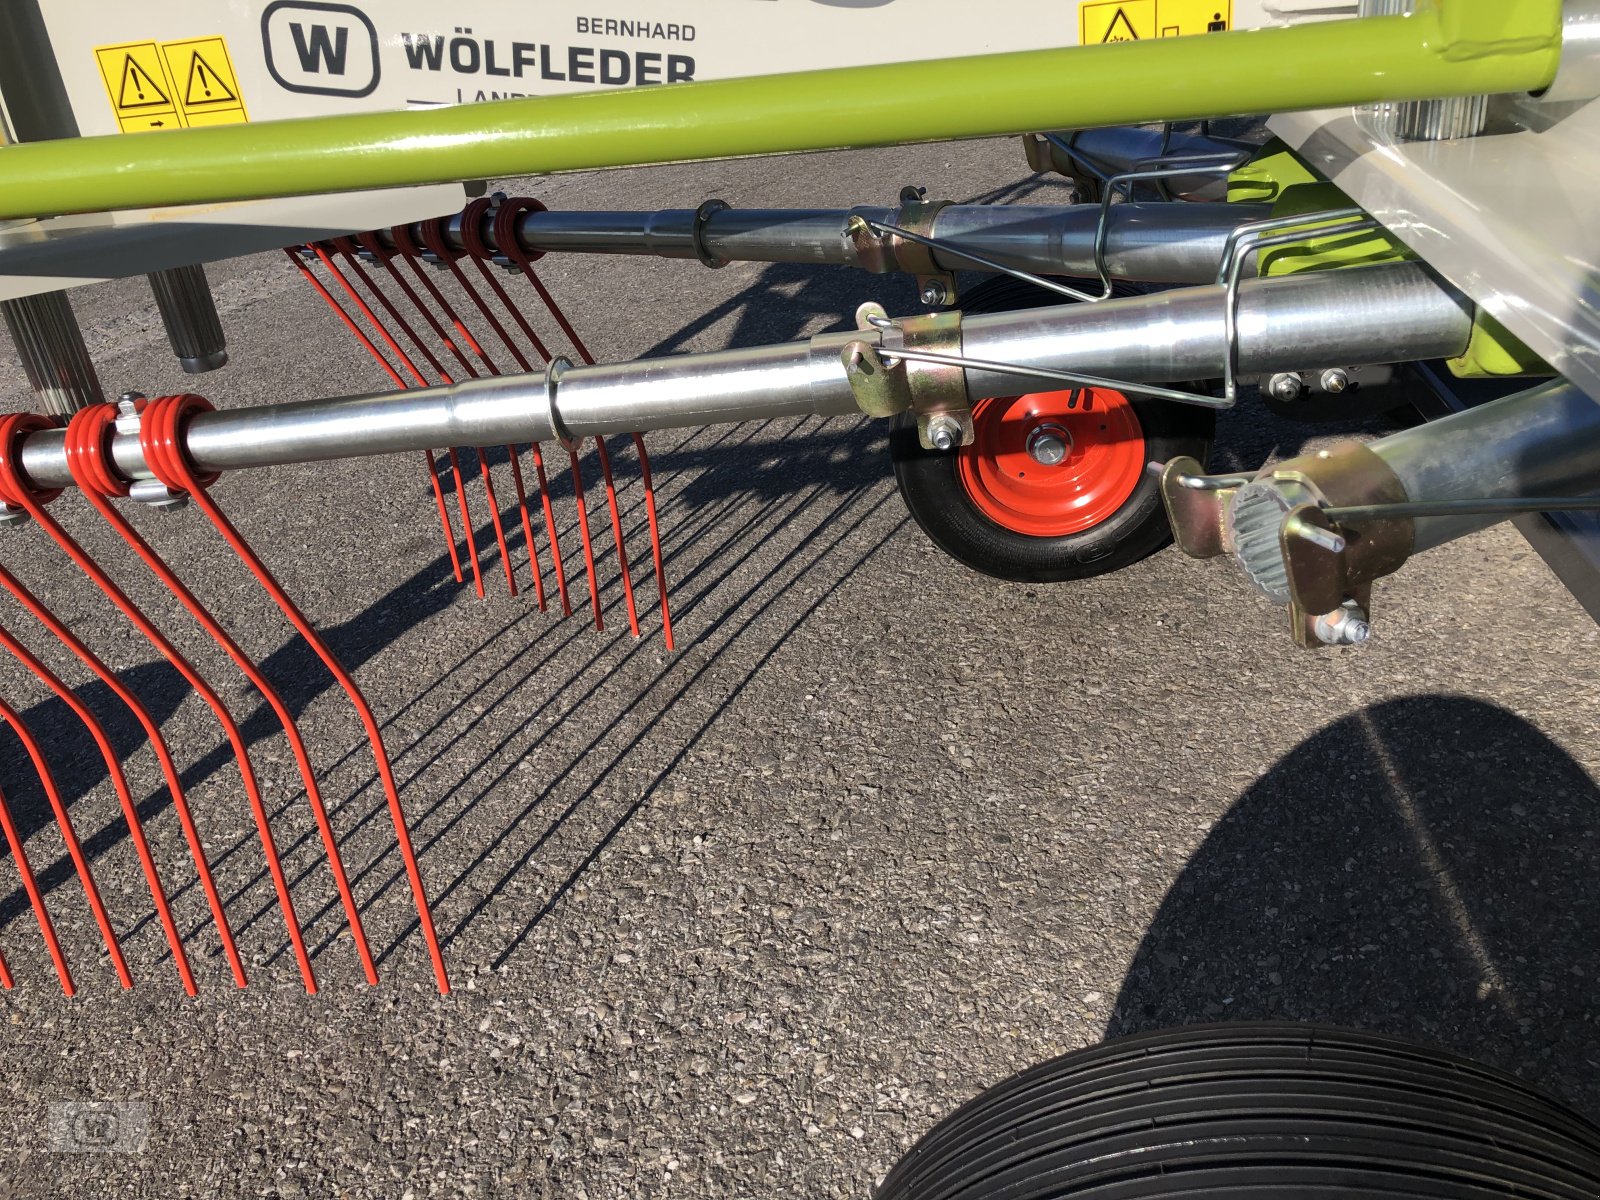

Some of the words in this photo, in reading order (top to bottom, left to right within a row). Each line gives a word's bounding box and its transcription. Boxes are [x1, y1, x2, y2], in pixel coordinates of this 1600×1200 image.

[288, 22, 349, 75] W
[576, 16, 696, 42] BERNHARD
[401, 27, 696, 86] WÖLFLEDER
